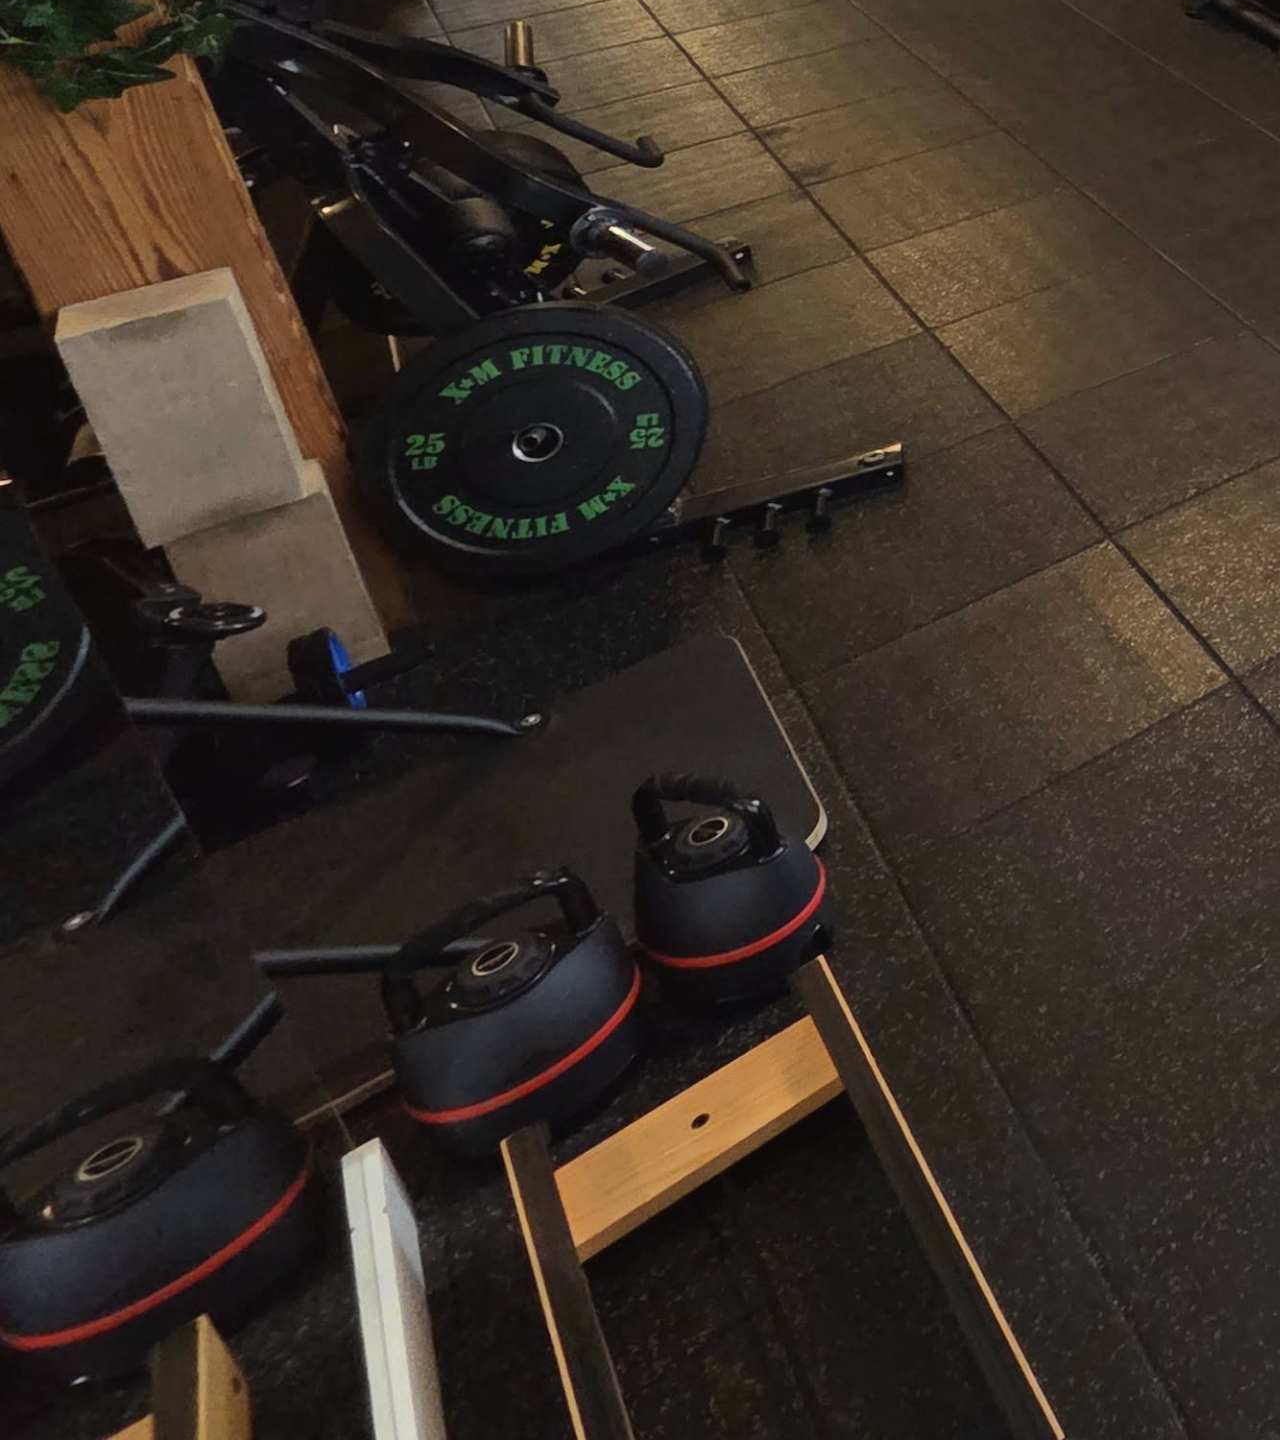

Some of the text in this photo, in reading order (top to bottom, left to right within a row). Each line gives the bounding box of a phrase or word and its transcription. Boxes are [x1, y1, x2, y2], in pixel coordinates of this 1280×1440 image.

[509, 344, 642, 392] FITNESS
[636, 412, 660, 427] LB
[404, 432, 447, 457] 25
[628, 426, 666, 450] 25
[411, 455, 439, 471] LB
[432, 494, 570, 541] FITNESS
